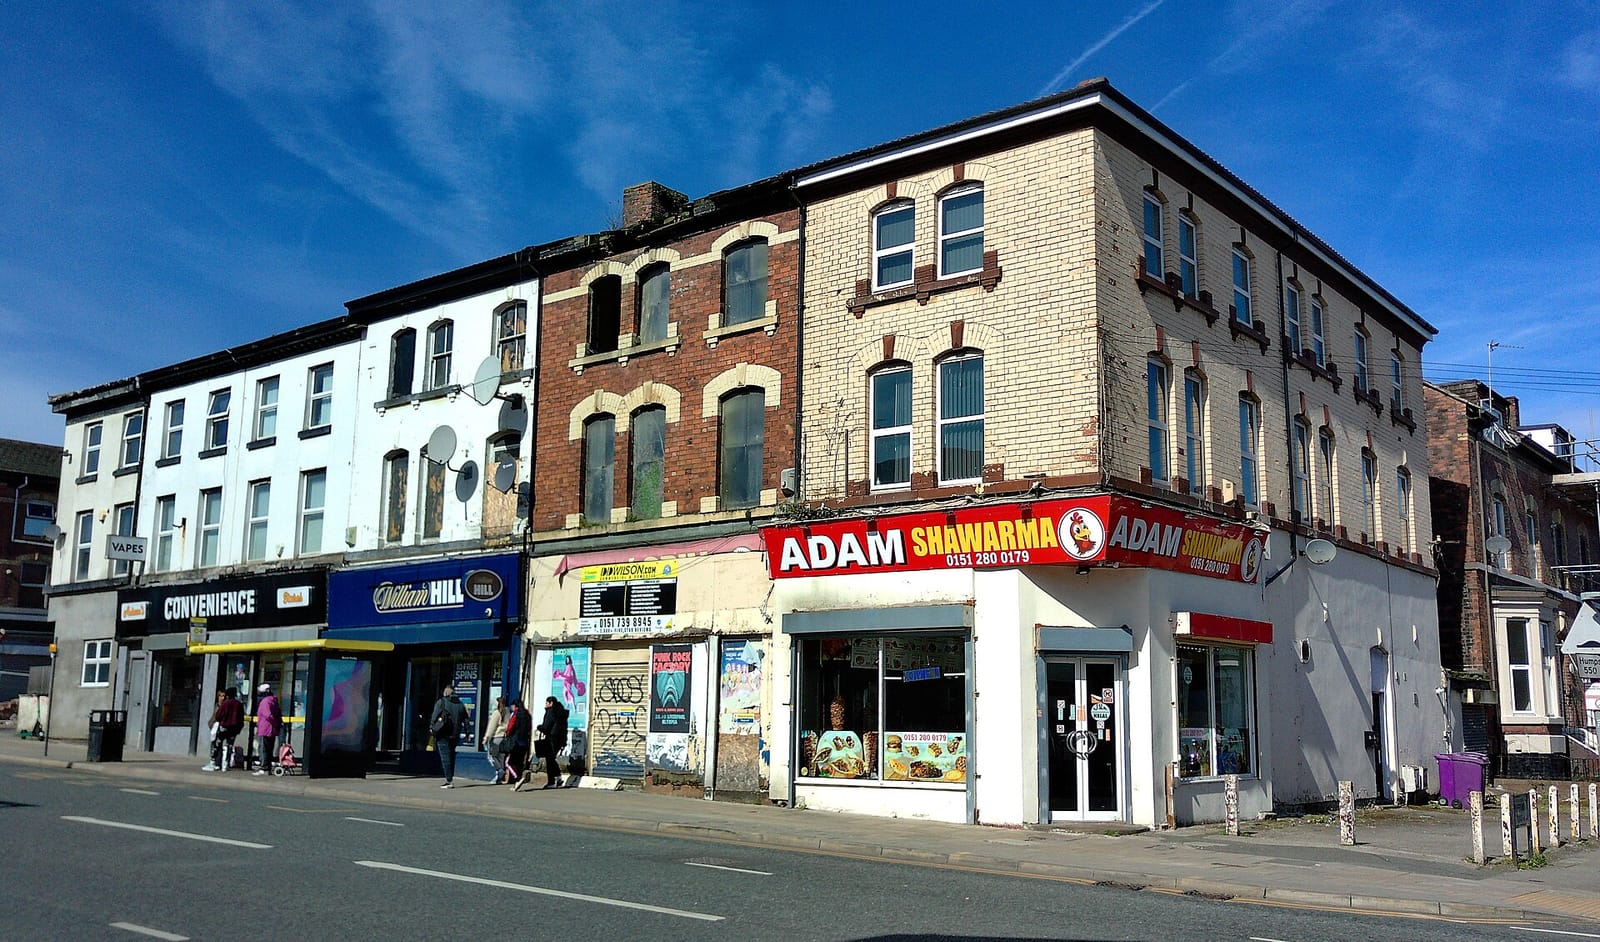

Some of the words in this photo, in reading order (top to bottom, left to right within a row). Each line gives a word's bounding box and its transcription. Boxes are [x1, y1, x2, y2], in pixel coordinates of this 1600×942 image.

[780, 529, 906, 571] ADAM
[911, 517, 1058, 557] SHAWARMA
[1109, 515, 1182, 557] ADAM
[1182, 530, 1243, 565] SHAWARMA
[112, 542, 144, 554] VAPES
[946, 554, 972, 566] 0151
[976, 552, 997, 565] 280
[1000, 550, 1030, 563] 0179
[1191, 557, 1204, 570] 0151
[1205, 560, 1216, 572] 280
[1216, 562, 1229, 574] 0179
[374, 583, 430, 609] William
[430, 579, 464, 605] HILL
[474, 584, 493, 595] HILL
[164, 589, 255, 620] CONVENIENCE
[599, 618, 614, 628] 0151
[617, 617, 630, 627] 739
[633, 616, 652, 627] 8945
[653, 653, 671, 662] PUNK
[673, 652, 691, 662] ROCK
[455, 670, 478, 680] SPINS
[1584, 666, 1598, 675] 550
